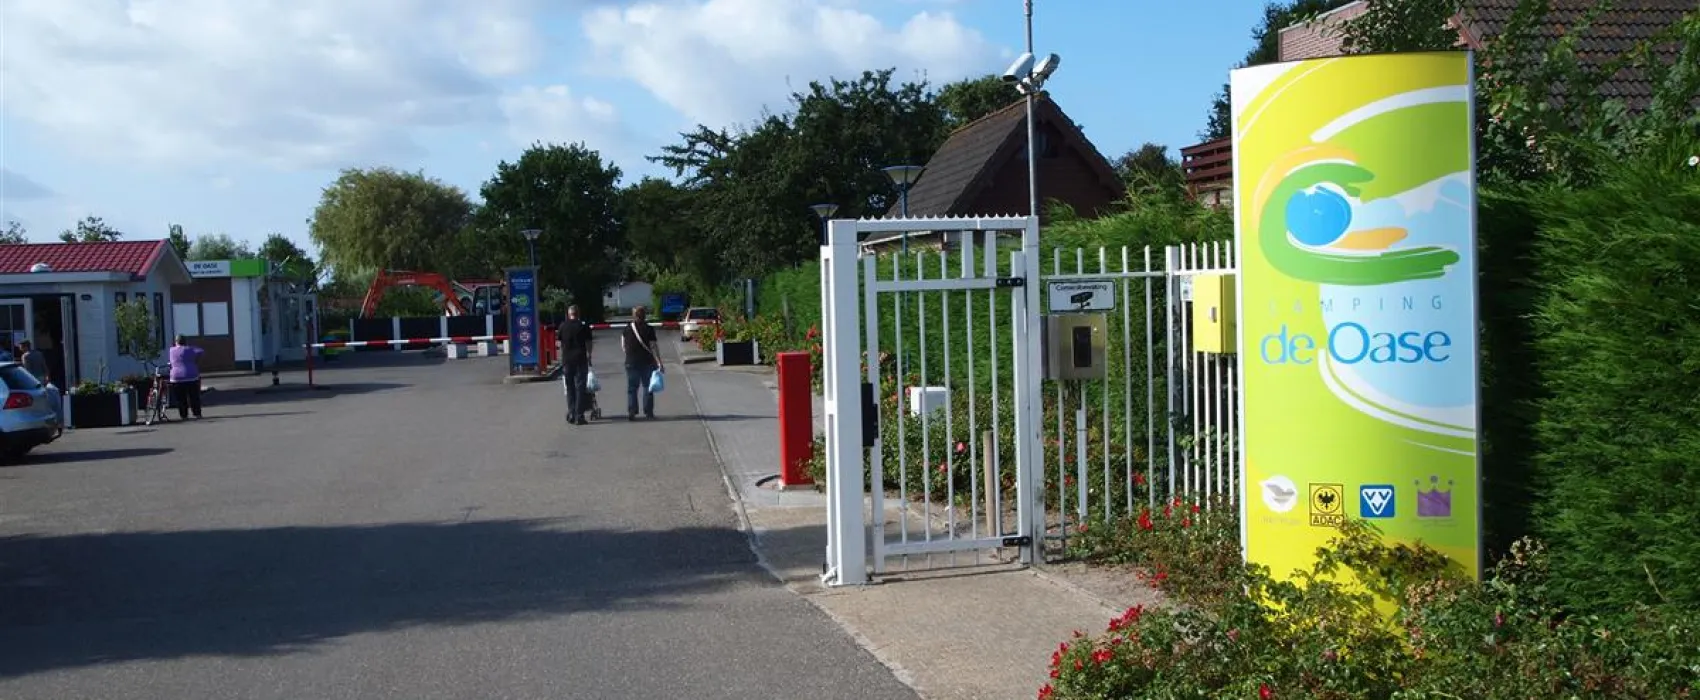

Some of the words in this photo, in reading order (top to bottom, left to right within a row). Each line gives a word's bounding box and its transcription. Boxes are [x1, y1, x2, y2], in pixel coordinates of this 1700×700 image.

[1261, 324, 1314, 364] de
[1328, 322, 1451, 364] Oase
[1313, 515, 1341, 525] ADAC
